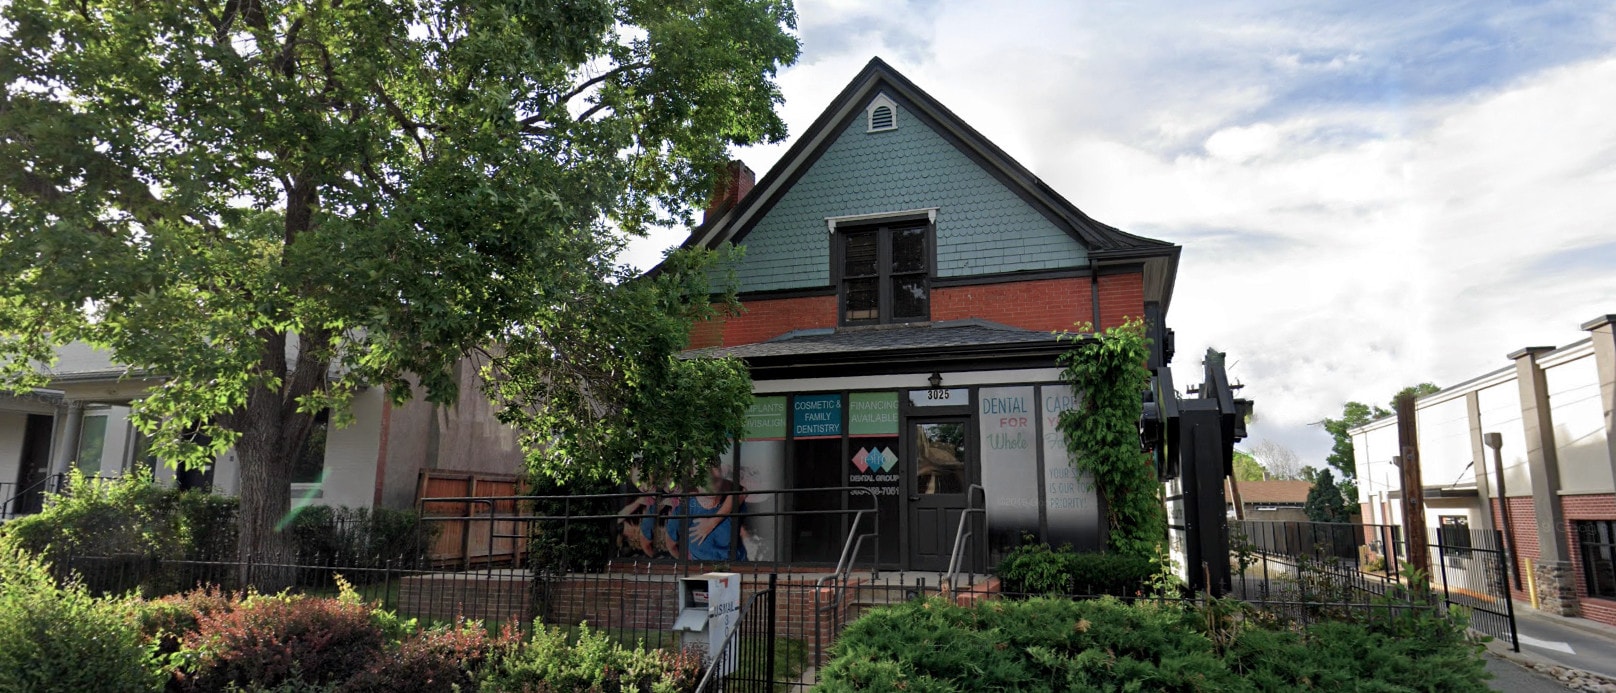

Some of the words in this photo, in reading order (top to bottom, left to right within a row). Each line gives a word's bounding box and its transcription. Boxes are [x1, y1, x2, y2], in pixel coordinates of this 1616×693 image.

[927, 389, 950, 400] 3025
[744, 403, 784, 415] MPLANTS
[794, 400, 834, 411] COSMETIC
[836, 399, 842, 409] &
[983, 397, 1028, 415] DENTAL
[804, 412, 832, 422] FAMILY
[851, 412, 899, 423] AVAILABLE
[1000, 417, 1028, 428] FOR
[796, 423, 840, 434] DENTISTRY
[986, 432, 1029, 450] Whole
[850, 474, 875, 482] DENTAL
[875, 474, 900, 482] GROUP
[1049, 467, 1069, 479] YOUR
[1049, 482, 1057, 494] IS
[1058, 482, 1075, 494] OUR
[1050, 497, 1087, 509] PRIORITY!
